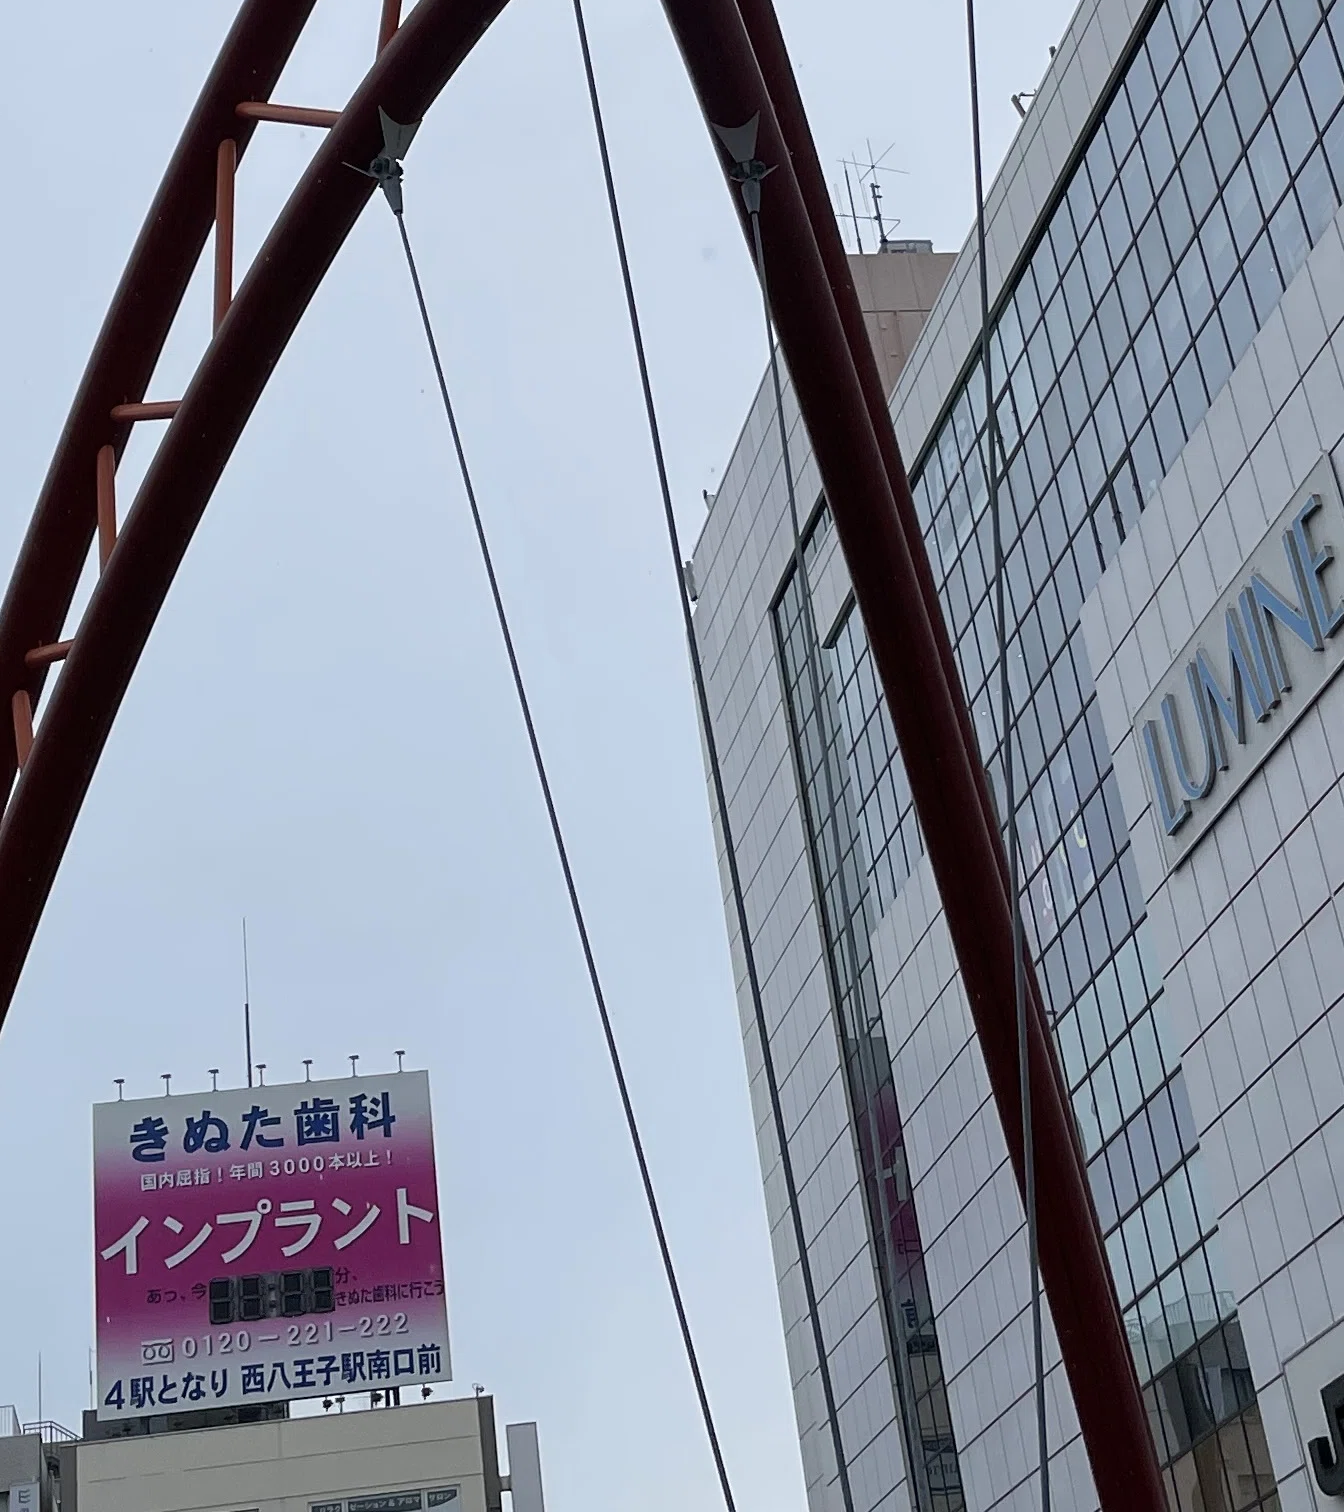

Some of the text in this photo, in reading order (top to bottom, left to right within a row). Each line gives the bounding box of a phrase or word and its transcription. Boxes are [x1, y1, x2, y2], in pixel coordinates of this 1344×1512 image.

[129, 1091, 397, 1164] きぬた歯科
[100, 1187, 434, 1275] インプラント
[104, 1343, 442, 1410] 4駅となり 西八王子駅南口前
